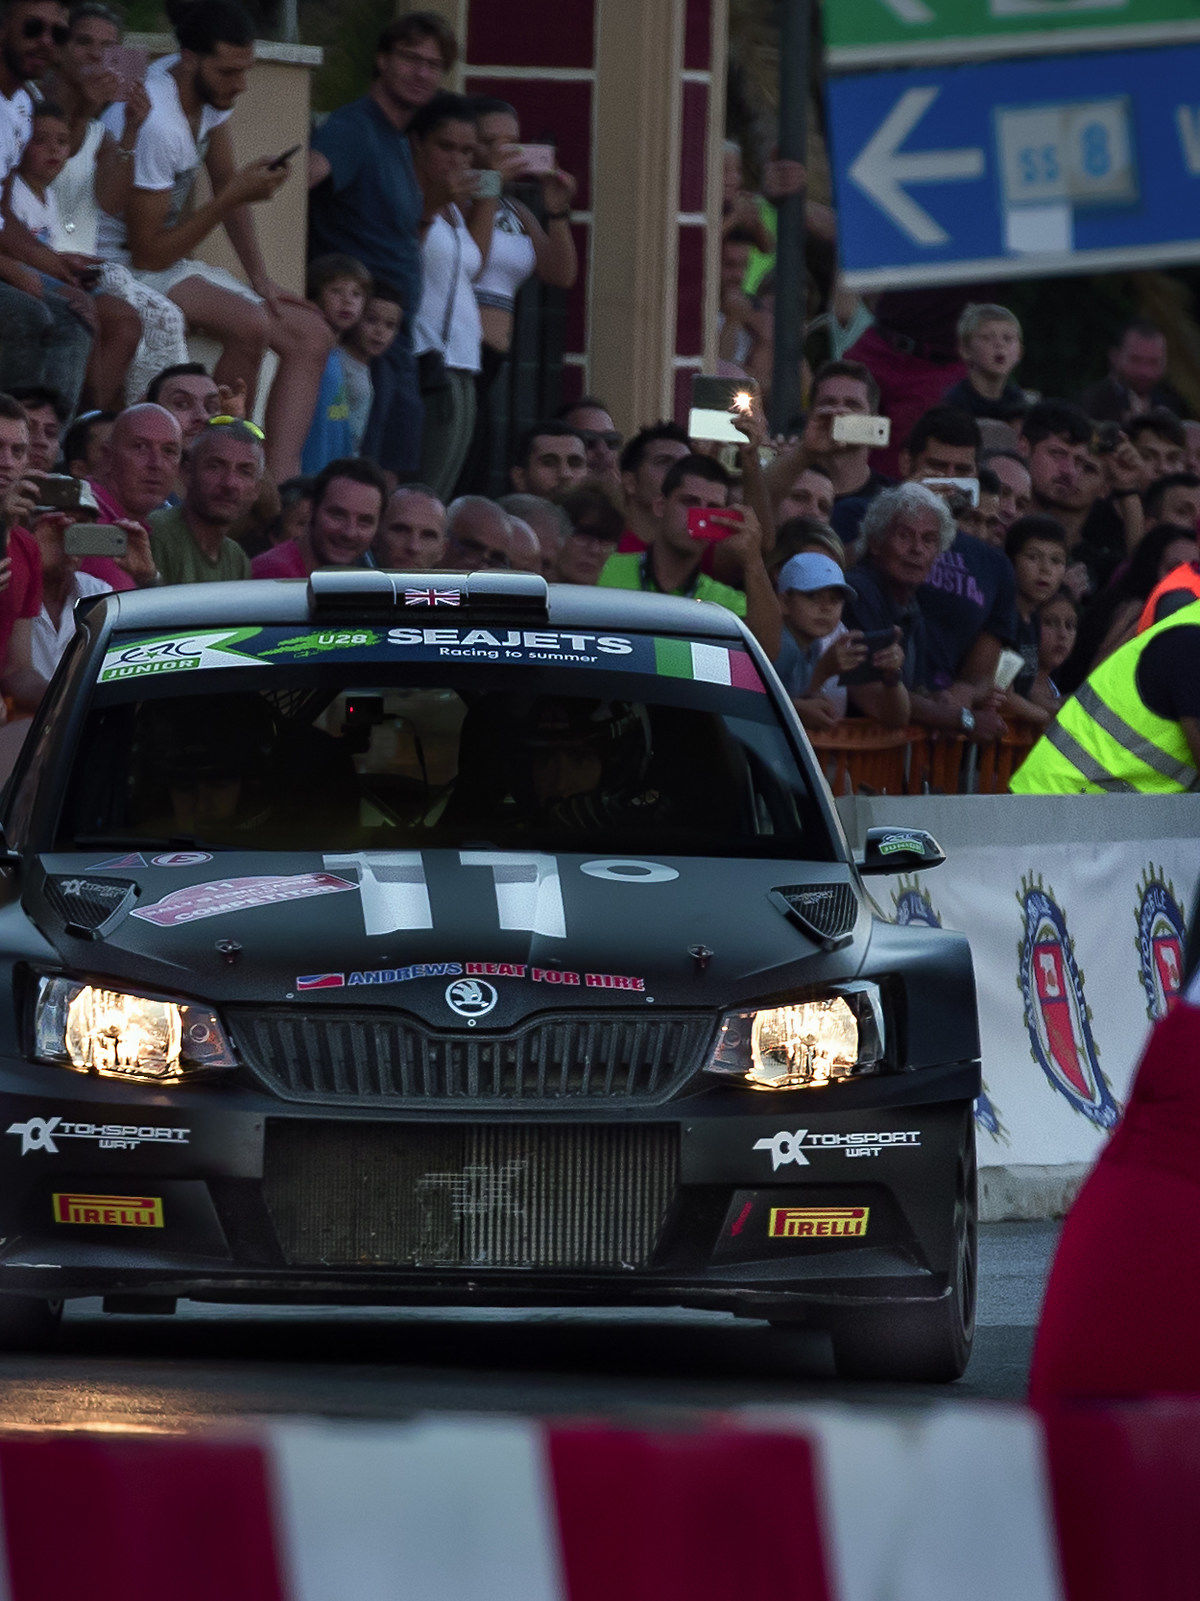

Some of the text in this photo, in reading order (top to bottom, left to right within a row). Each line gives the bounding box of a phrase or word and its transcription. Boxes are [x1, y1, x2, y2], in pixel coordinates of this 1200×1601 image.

[318, 633, 367, 645] U28
[387, 628, 633, 654] SEAJETS
[439, 647, 598, 663] Racing to summer
[107, 659, 195, 678] JUNIOR
[347, 962, 646, 992] ANDREWS HEAT FOR HIRE
[58, 1195, 156, 1226] PIRELLI
[773, 1208, 865, 1236] PIRELLI
